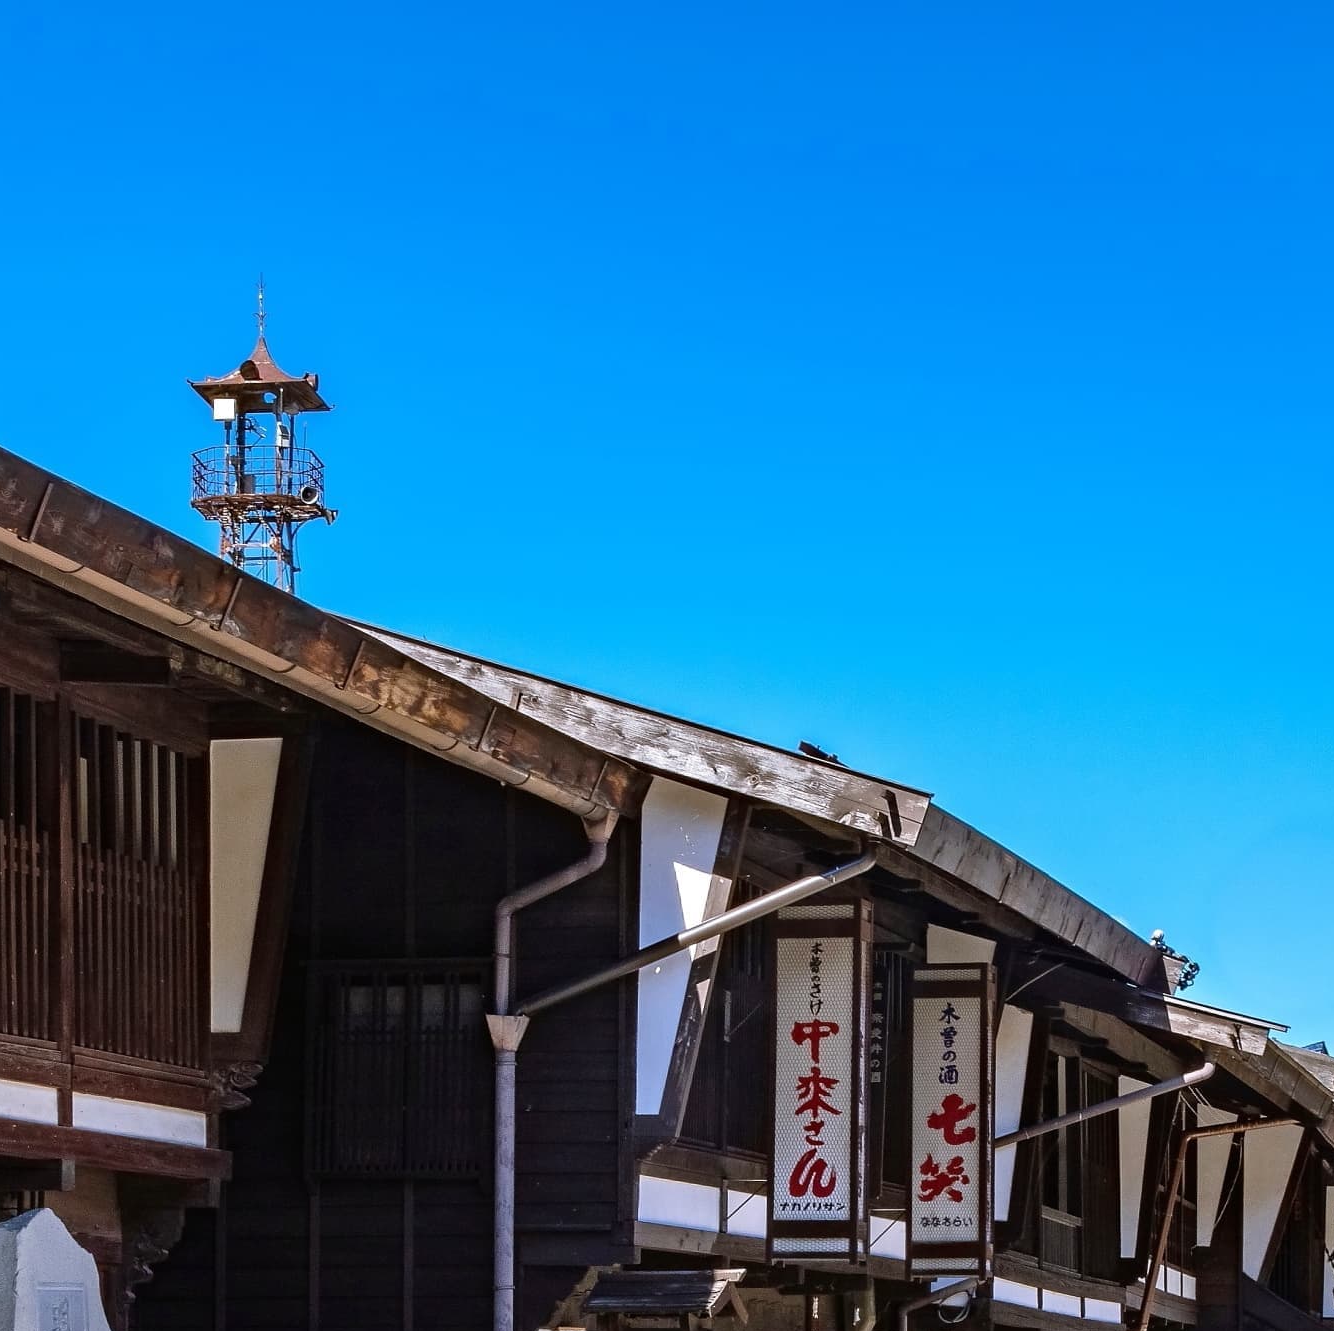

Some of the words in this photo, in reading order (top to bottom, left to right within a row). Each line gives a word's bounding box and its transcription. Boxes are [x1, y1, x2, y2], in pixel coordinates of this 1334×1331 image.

[918, 1093, 976, 1203] 七笑
[779, 1202, 846, 1212] ナカノリサン
